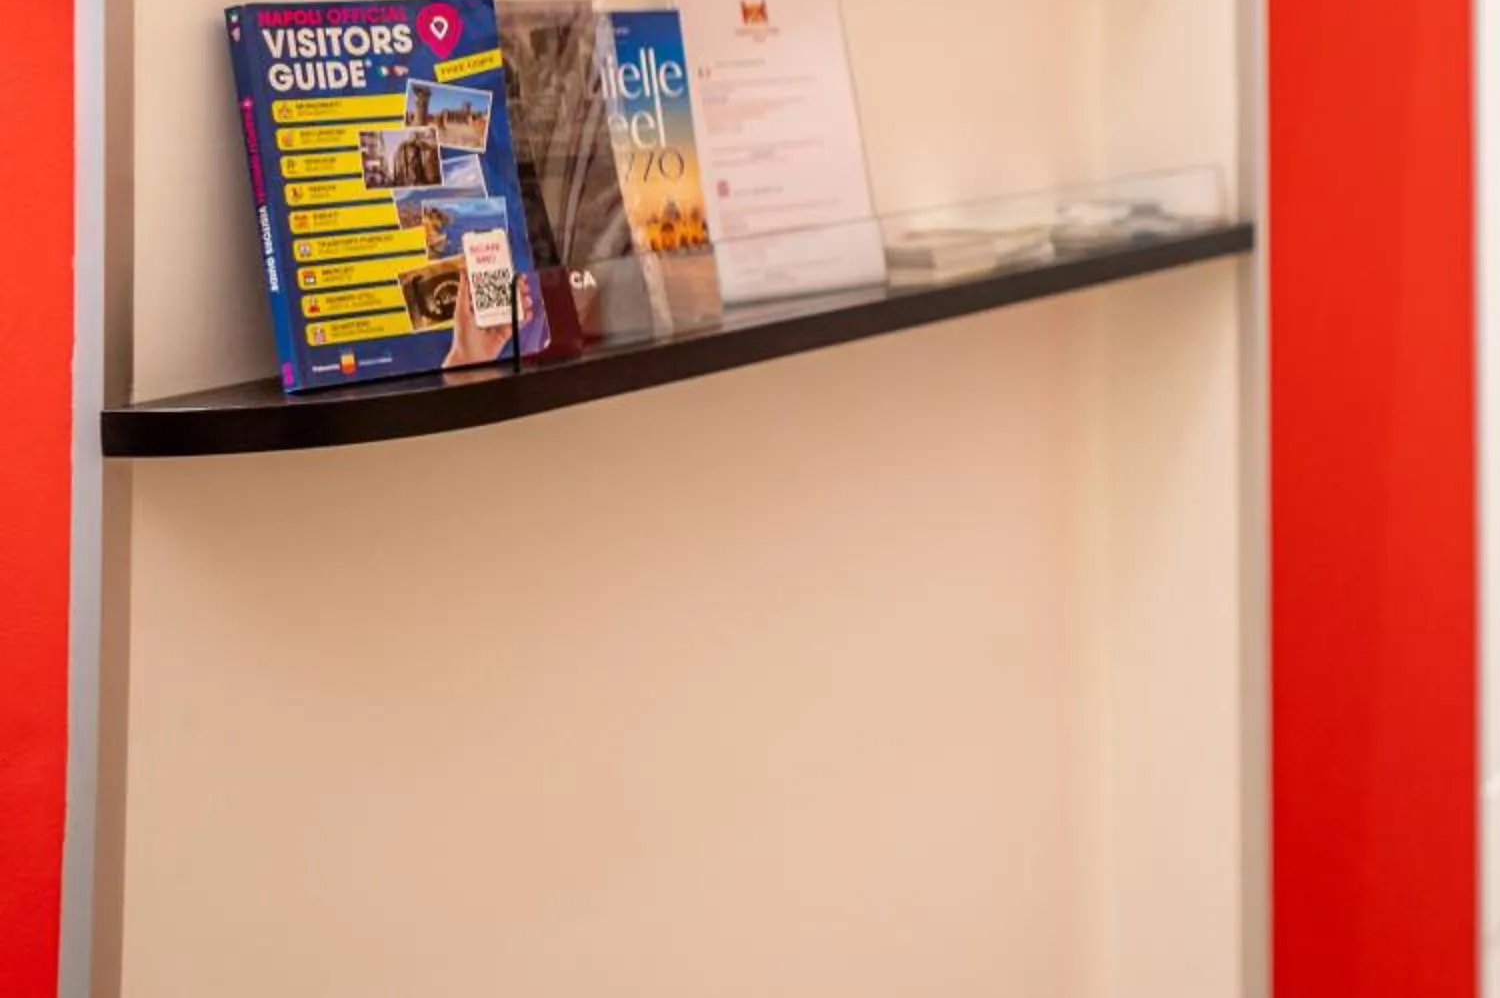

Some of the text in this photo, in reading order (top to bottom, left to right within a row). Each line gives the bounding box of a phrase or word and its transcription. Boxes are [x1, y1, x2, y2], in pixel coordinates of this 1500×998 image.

[326, 5, 408, 24] OFFICIAL
[262, 24, 413, 59] VISITORS
[268, 60, 368, 93] GUIDE
